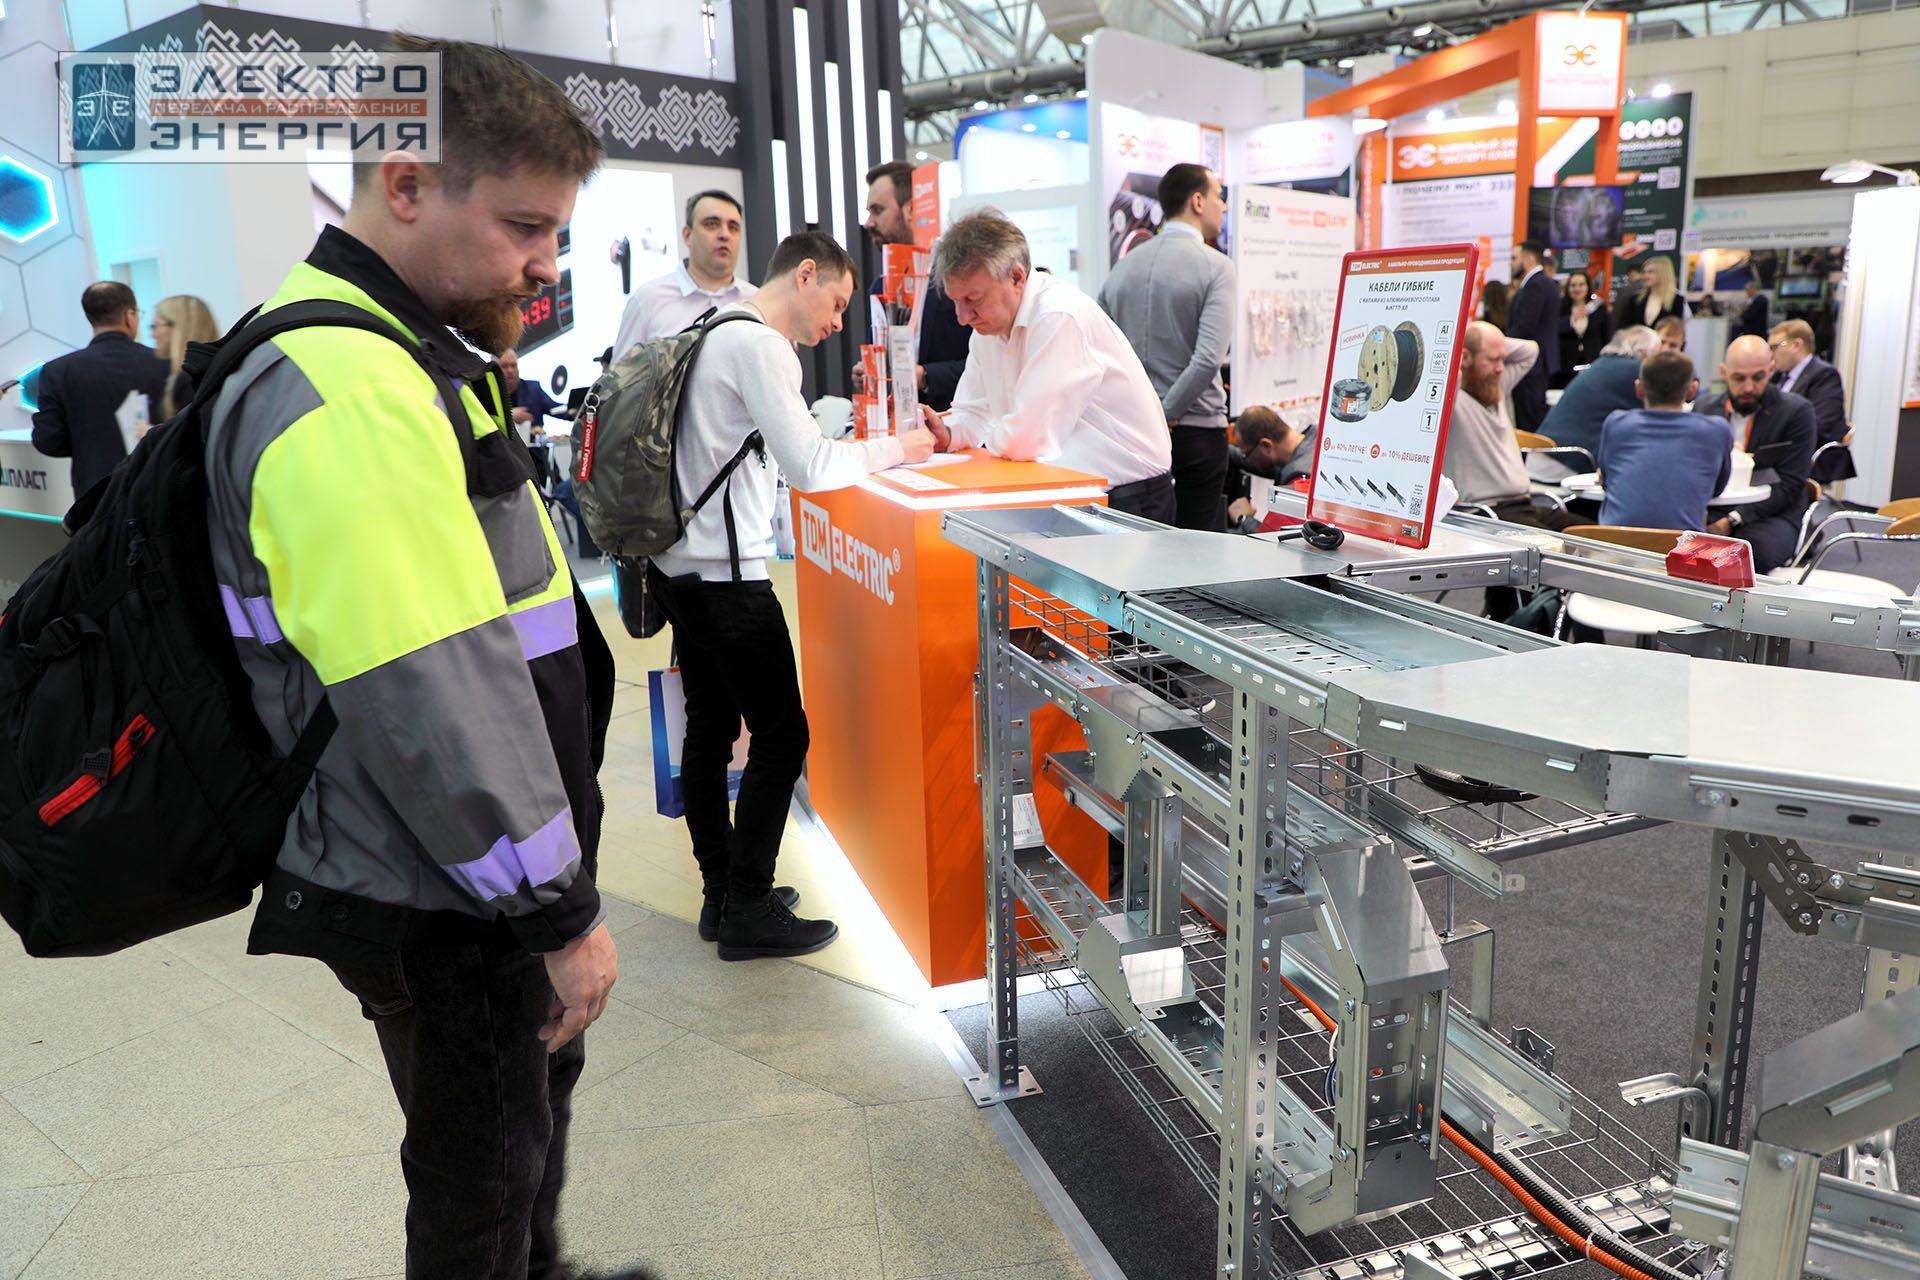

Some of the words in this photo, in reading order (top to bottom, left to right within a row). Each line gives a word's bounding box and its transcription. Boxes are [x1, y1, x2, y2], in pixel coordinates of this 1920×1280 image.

[1368, 282, 1400, 292] КАБЕЛИ
[1401, 281, 1434, 291] ГИБКИЕ
[1343, 332, 1365, 344] НОВИНКА
[1431, 385, 1437, 397] 5
[1427, 415, 1431, 426] 1
[800, 506, 830, 565] TDM
